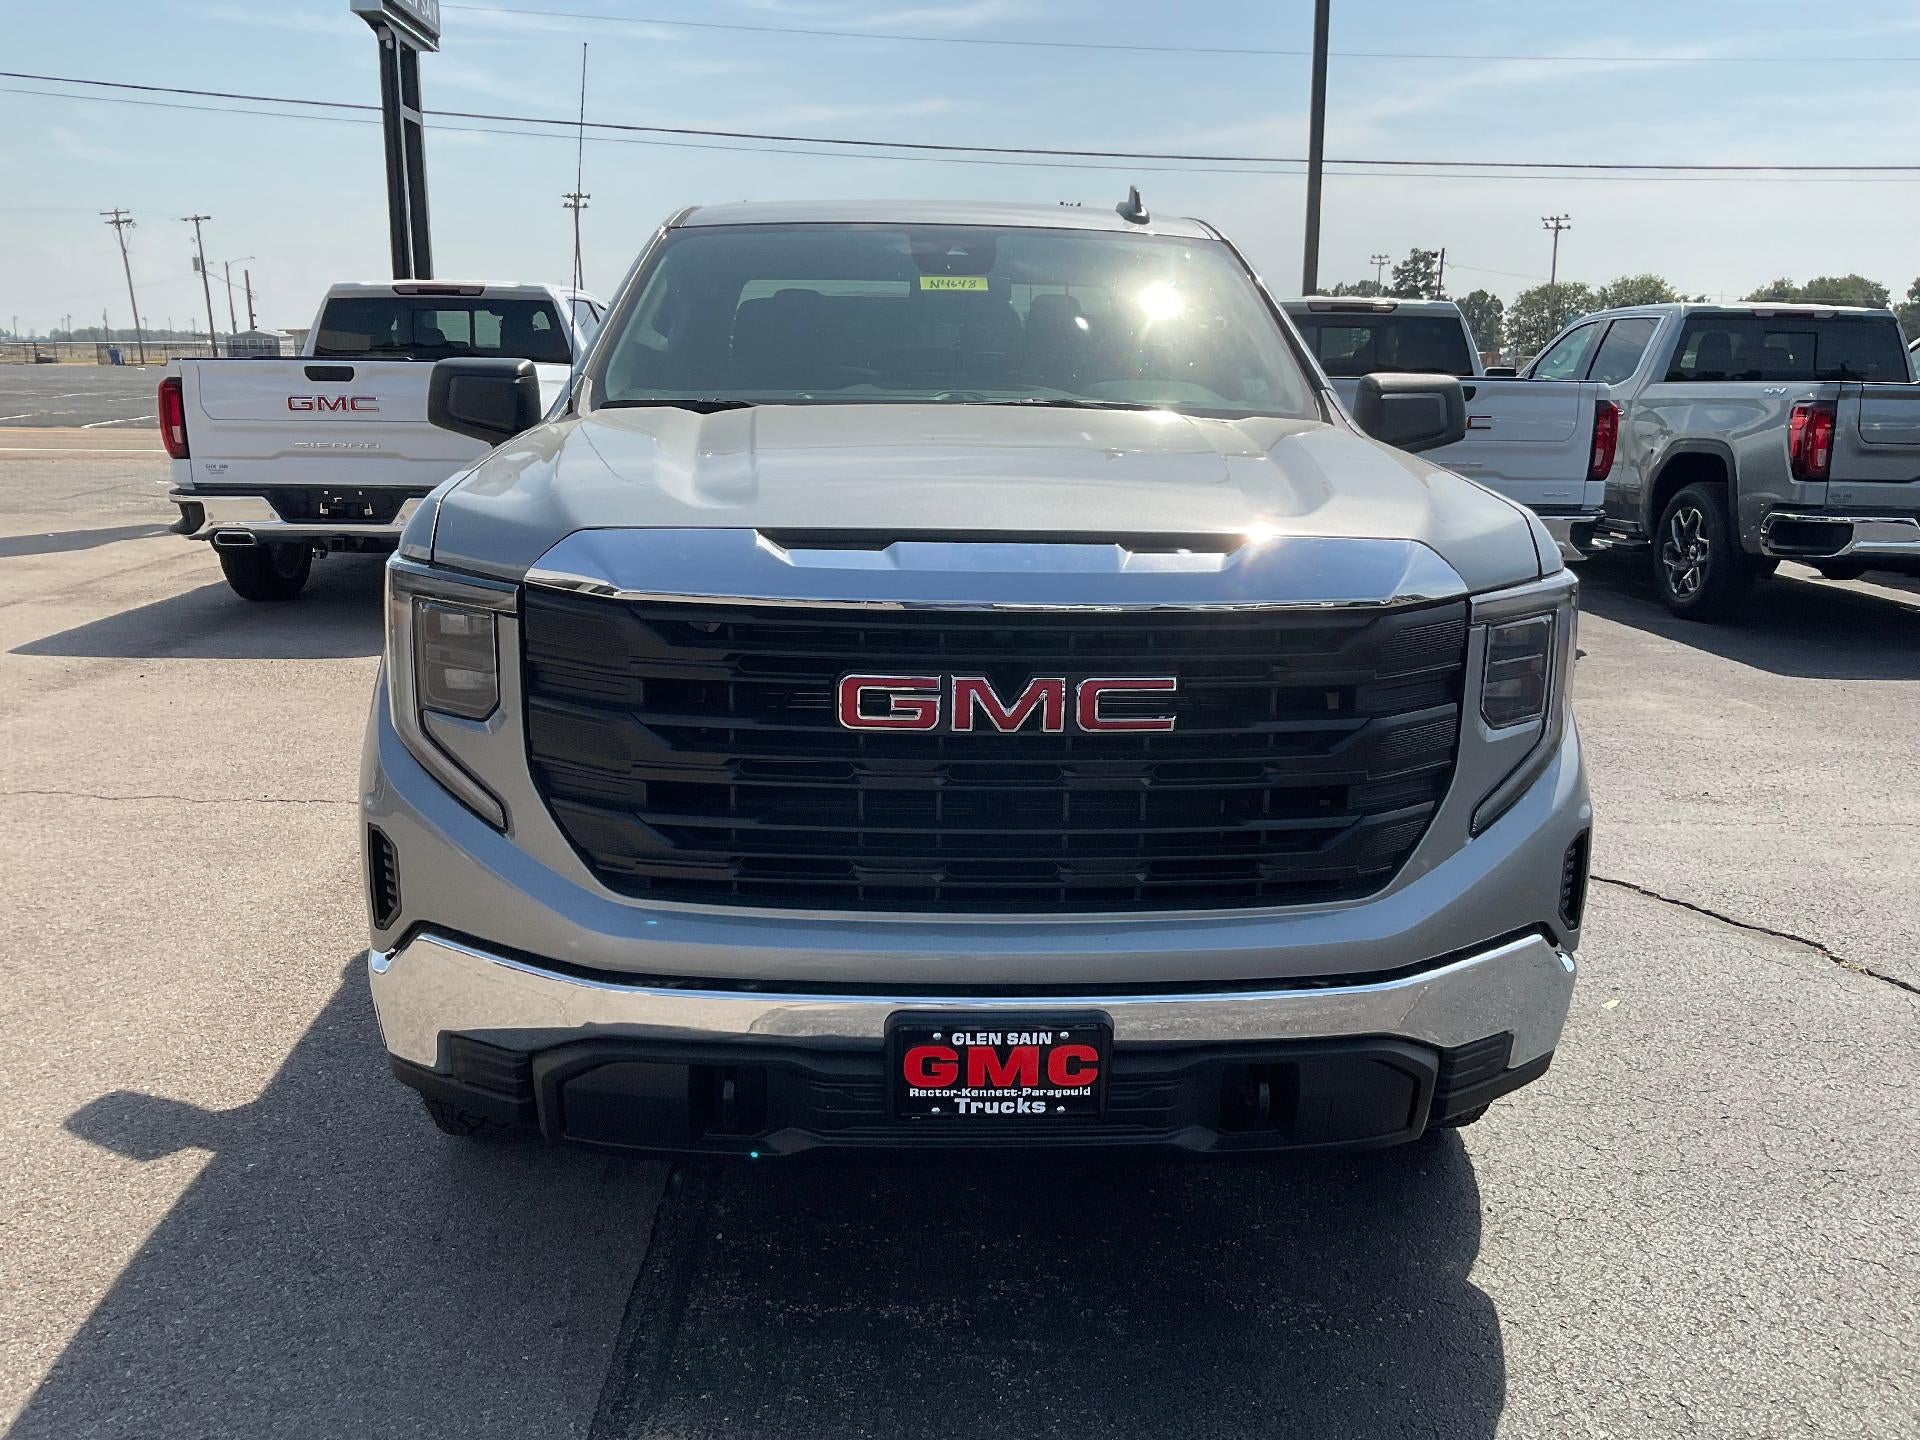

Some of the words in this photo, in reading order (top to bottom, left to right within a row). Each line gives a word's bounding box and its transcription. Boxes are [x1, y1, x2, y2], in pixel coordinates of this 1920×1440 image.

[287, 394, 380, 412] GMC
[838, 674, 1177, 733] GMC
[951, 1032, 1001, 1046] GLEN
[1006, 1031, 1052, 1045] SAIN
[903, 1044, 1099, 1088] GMC
[954, 1098, 1047, 1115] Trucks
